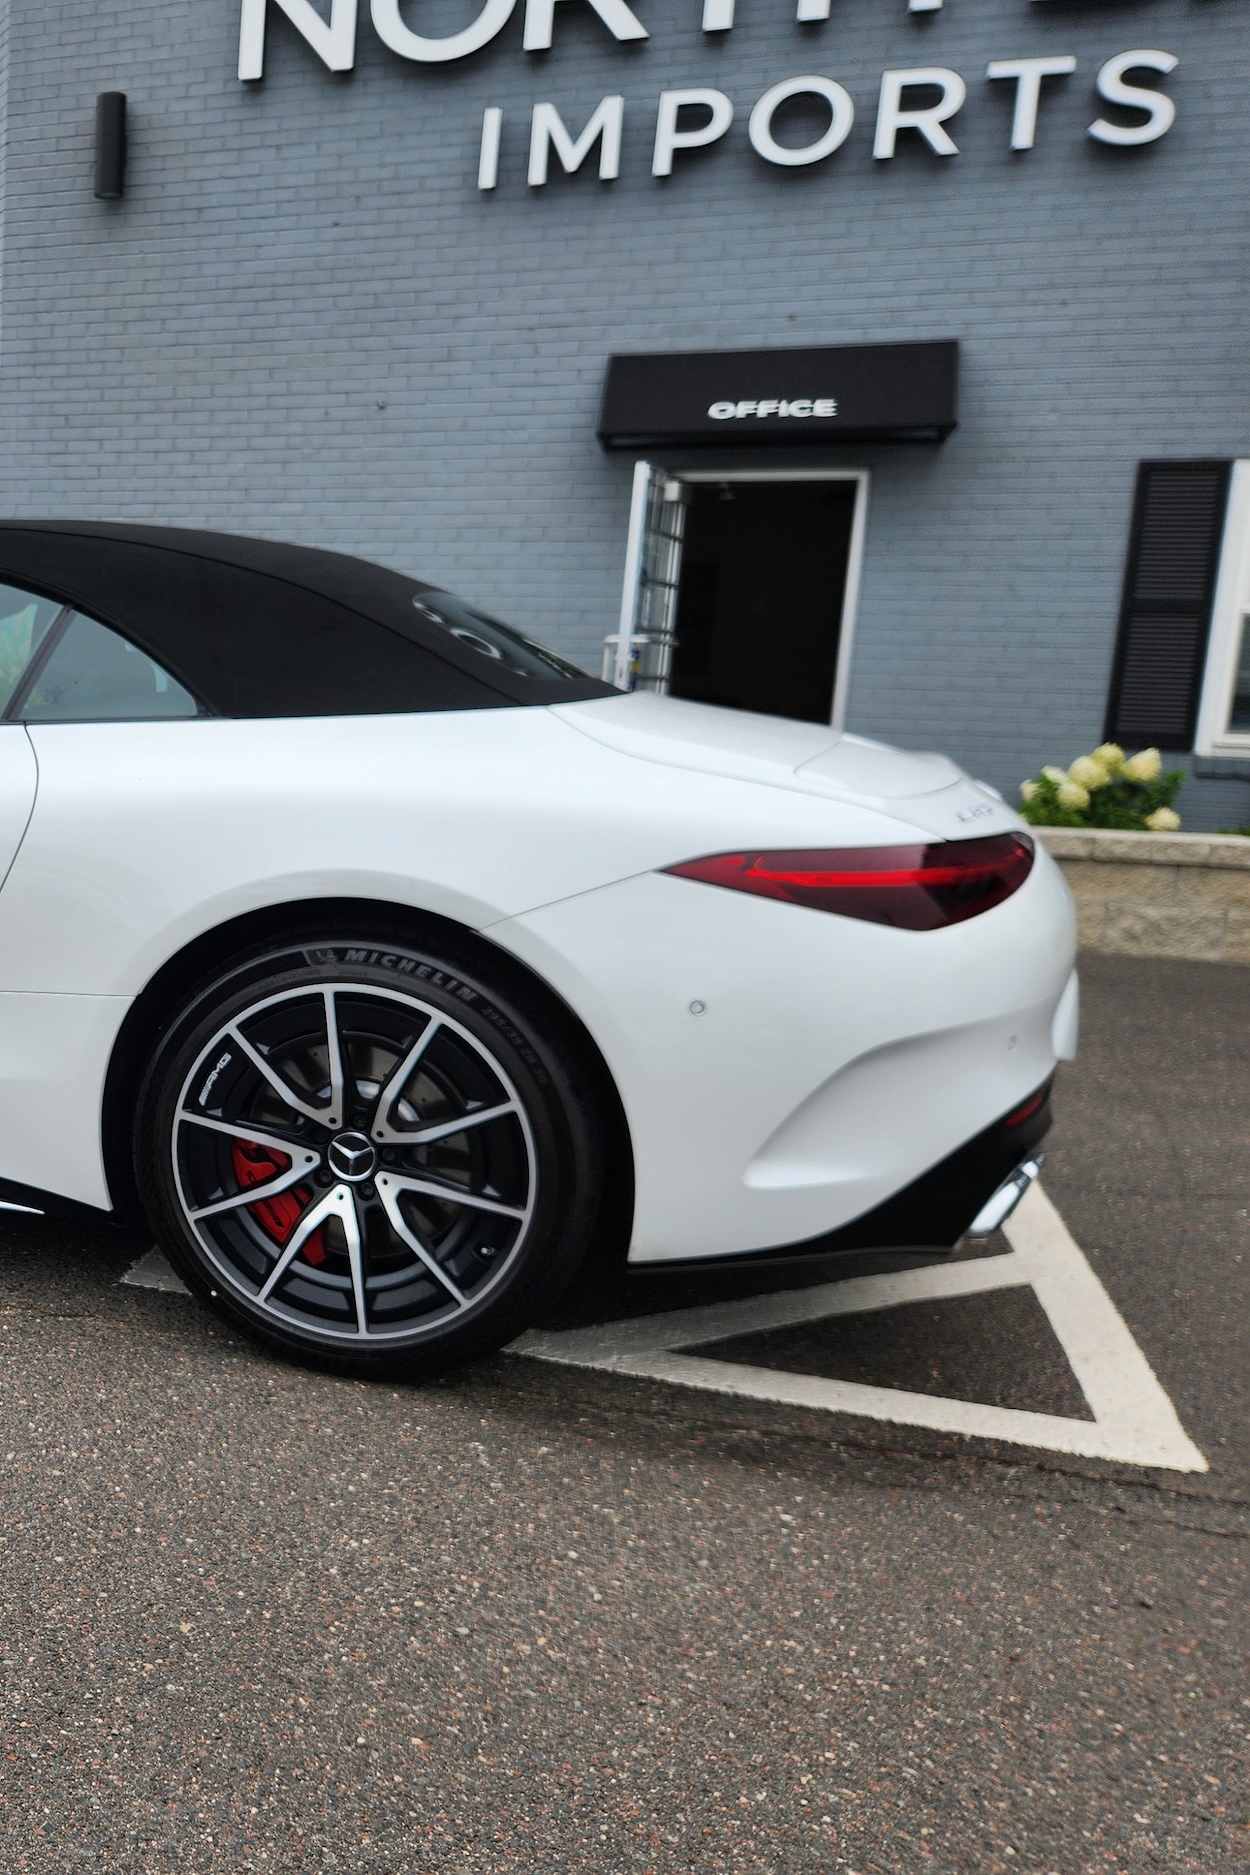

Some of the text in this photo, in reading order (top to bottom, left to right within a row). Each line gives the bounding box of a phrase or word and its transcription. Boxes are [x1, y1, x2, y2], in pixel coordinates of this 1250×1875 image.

[478, 48, 1180, 189] IMPORTS
[707, 398, 839, 420] OFFICE
[343, 948, 480, 1003] MICHELIN
